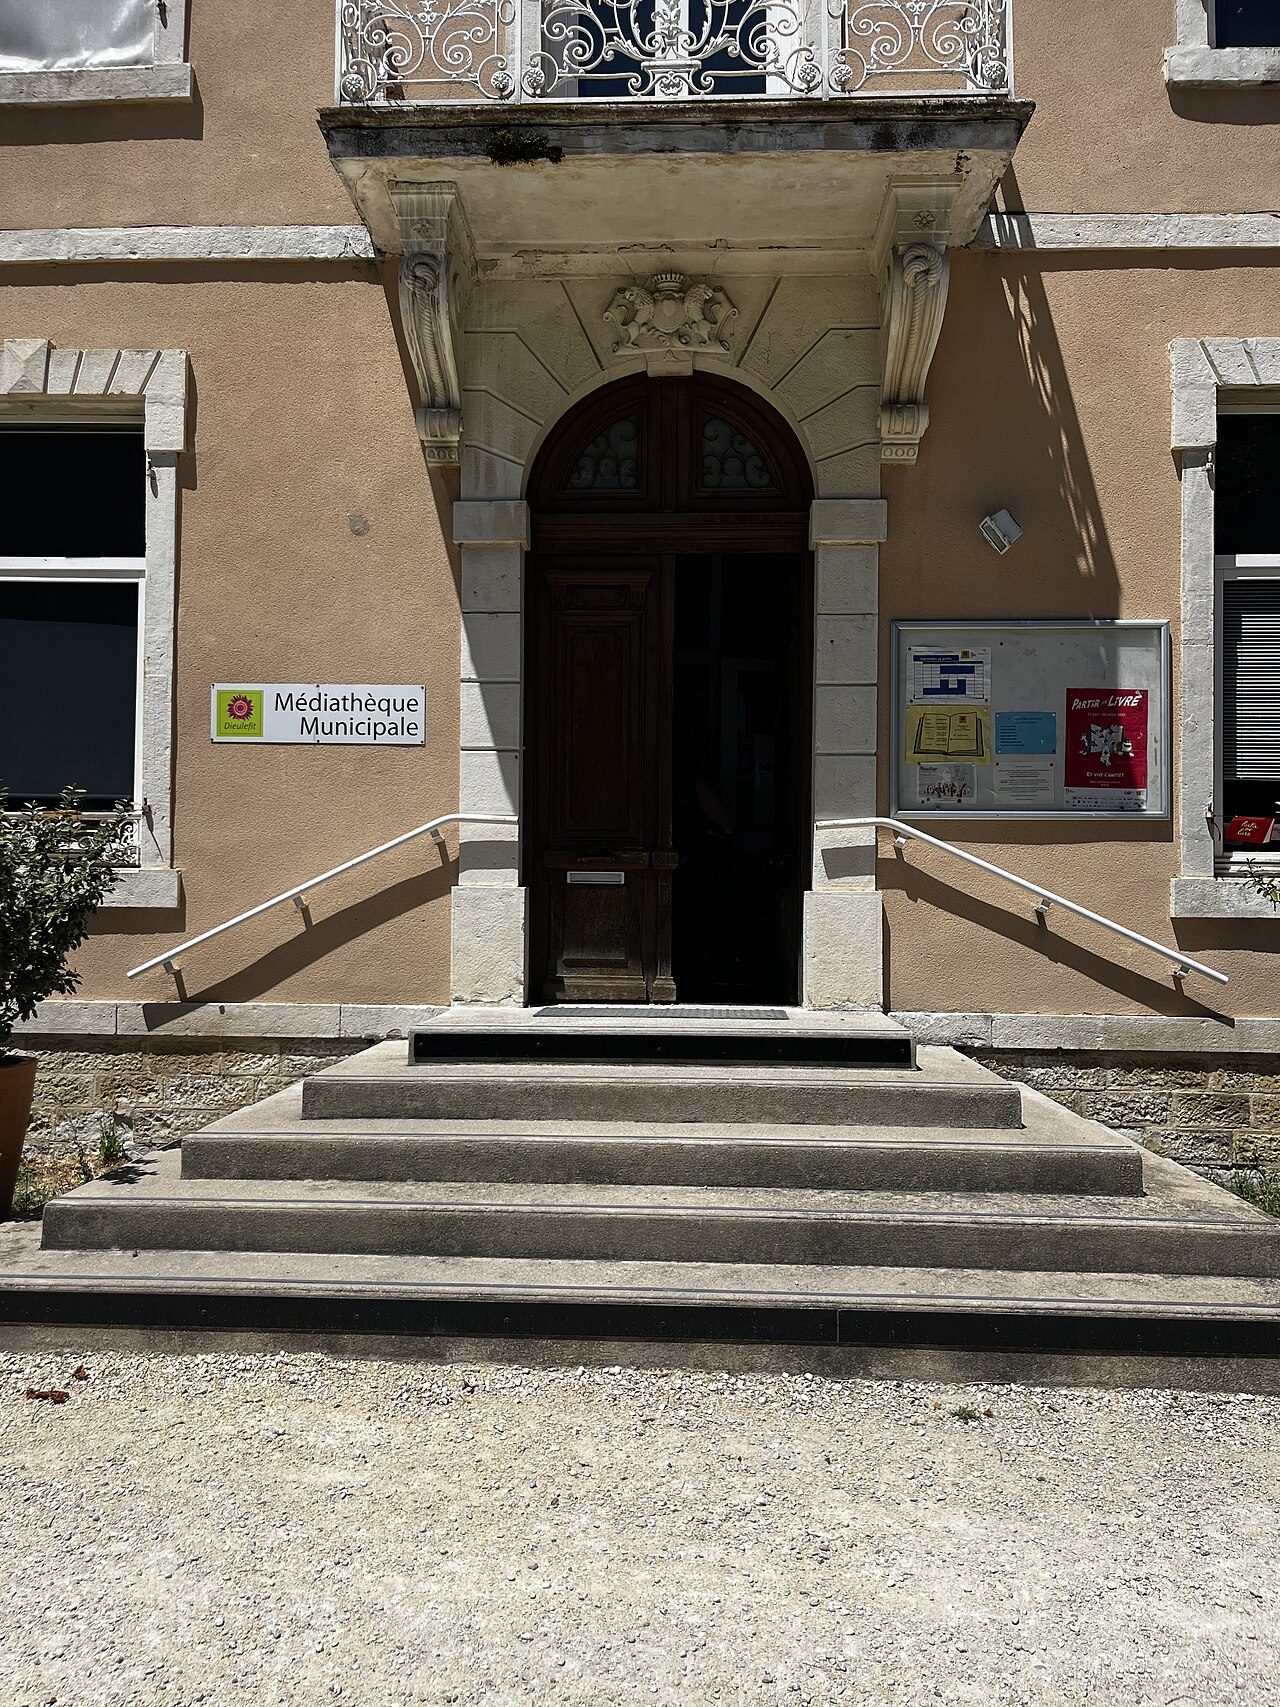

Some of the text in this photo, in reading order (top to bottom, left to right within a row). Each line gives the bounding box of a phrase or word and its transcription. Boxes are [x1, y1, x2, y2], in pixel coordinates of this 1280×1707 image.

[275, 692, 419, 716] Médiathèque
[224, 721, 257, 731] Dieulefit
[300, 716, 419, 740] Municipale
